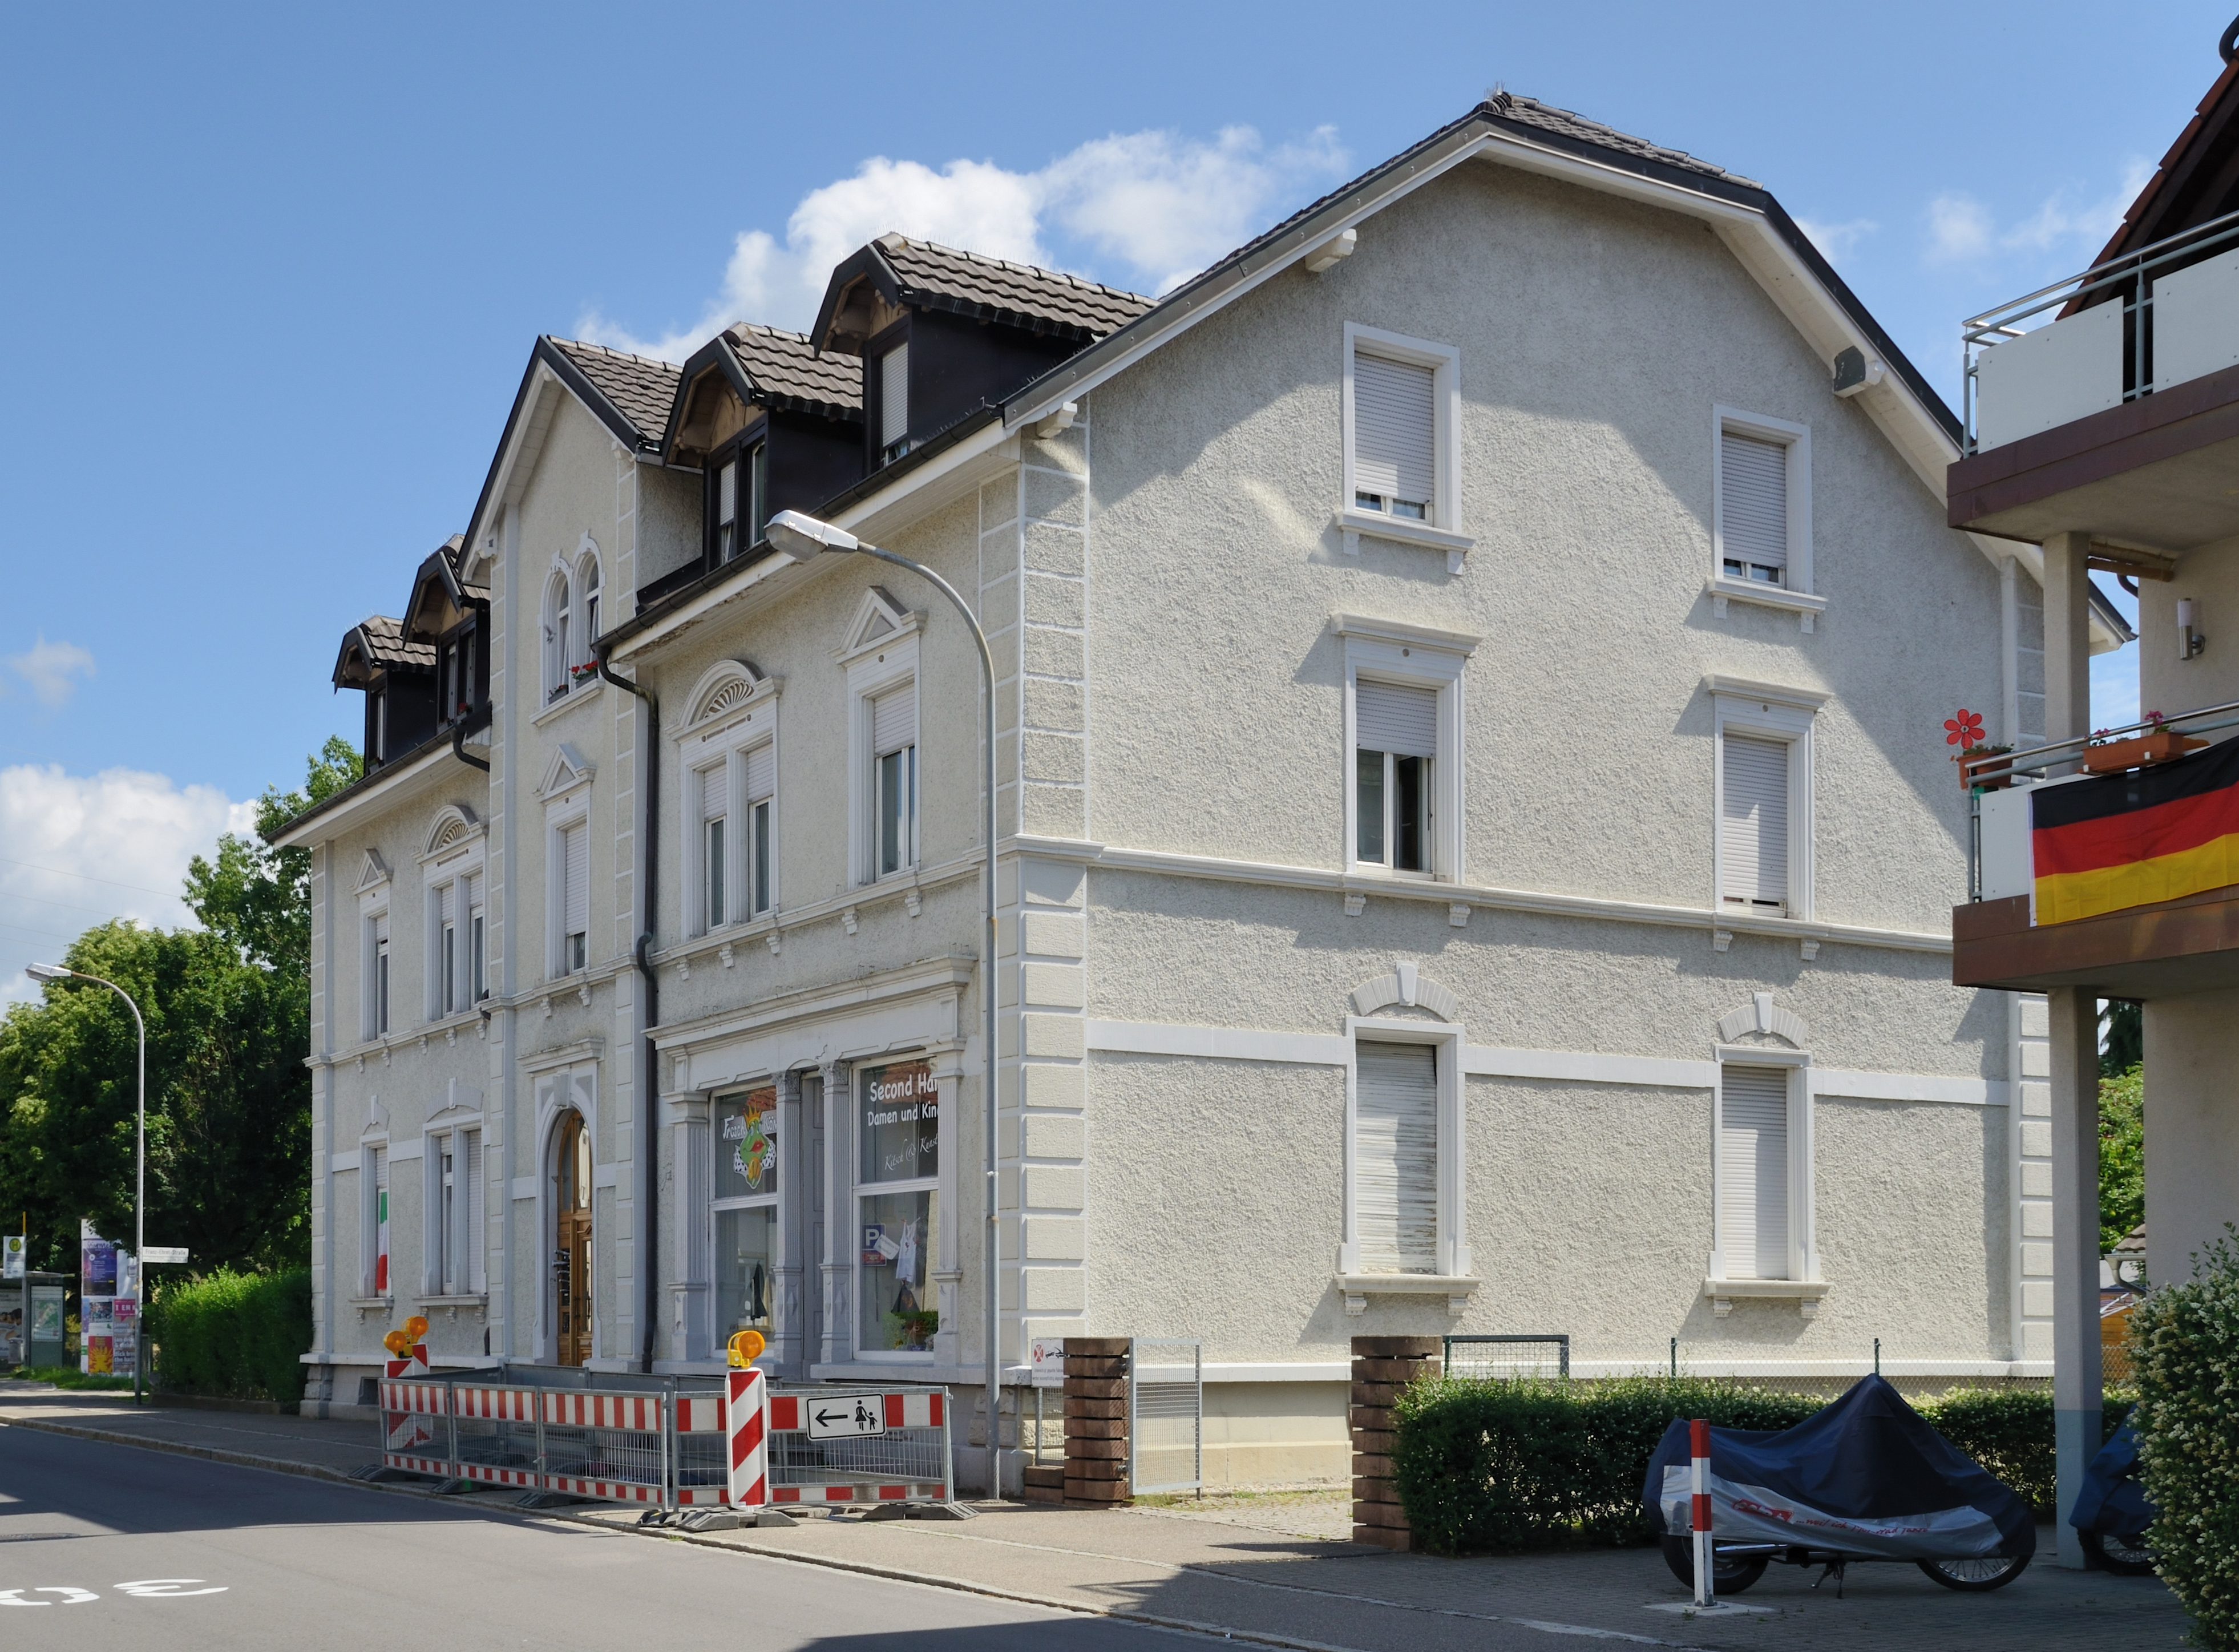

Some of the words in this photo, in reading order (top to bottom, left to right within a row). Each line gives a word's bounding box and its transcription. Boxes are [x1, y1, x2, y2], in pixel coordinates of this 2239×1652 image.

[870, 1074, 912, 1102] Second
[867, 1111, 897, 1126] Damen
[901, 1104, 918, 1121] und
[922, 1100, 938, 1119] Kin
[866, 1229, 879, 1246] P
